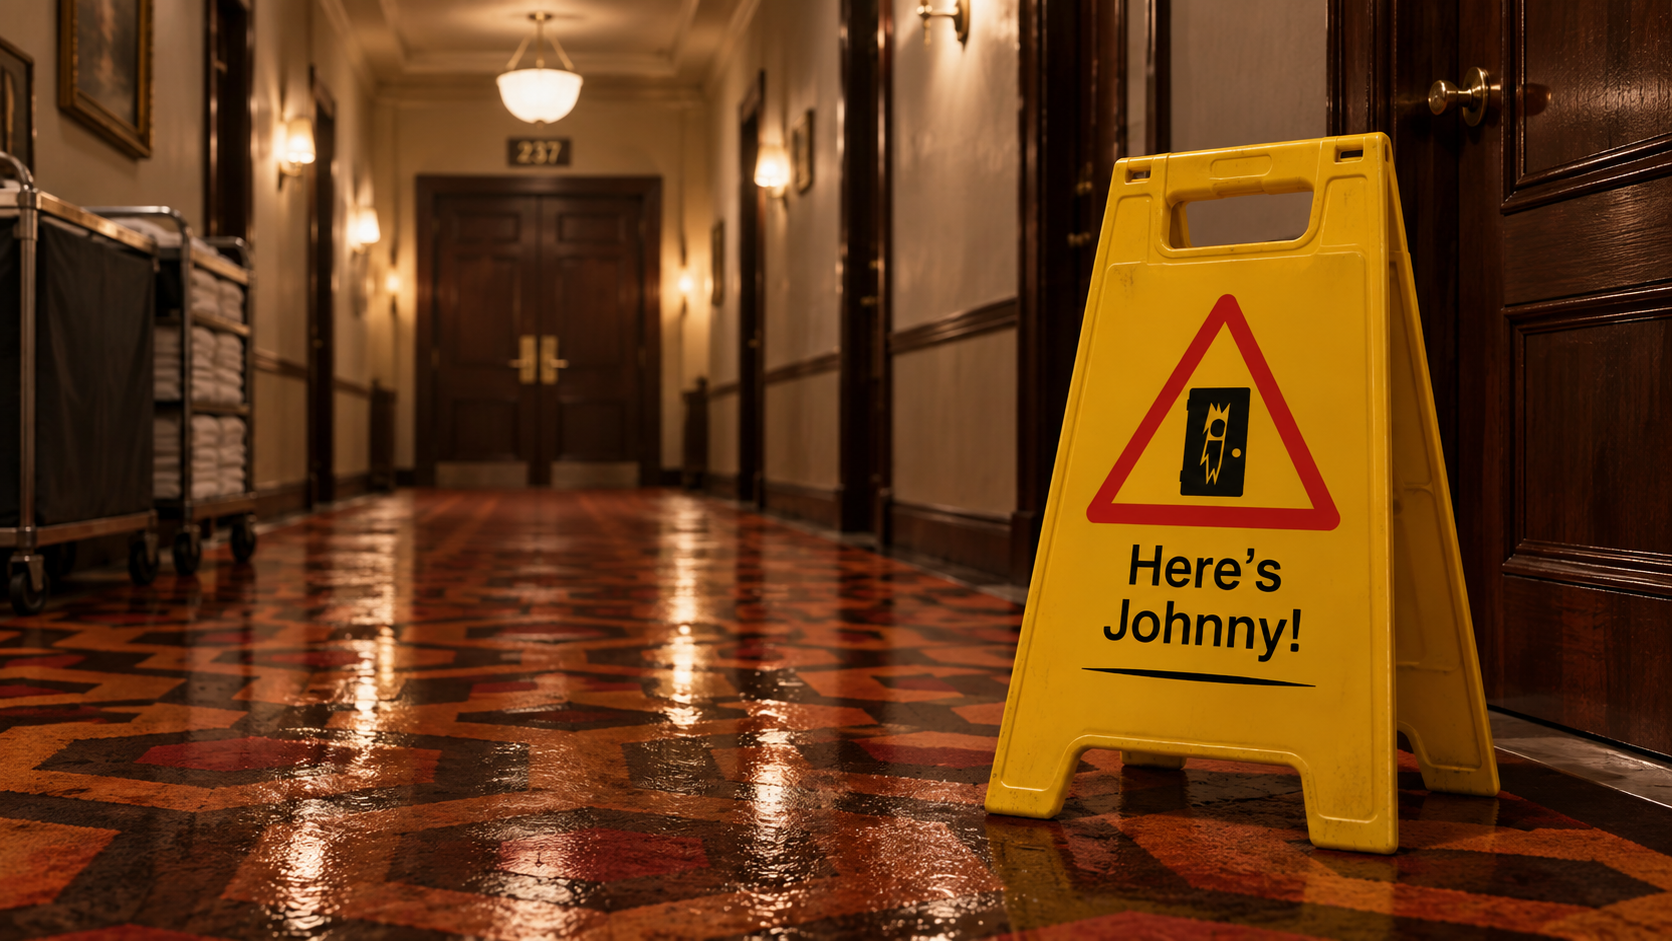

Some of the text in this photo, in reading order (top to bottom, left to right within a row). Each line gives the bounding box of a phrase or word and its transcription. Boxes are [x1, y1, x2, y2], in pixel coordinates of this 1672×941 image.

[516, 141, 562, 165] 237
[1128, 544, 1282, 592] Here’s
[1103, 599, 1302, 662] Johnny!
